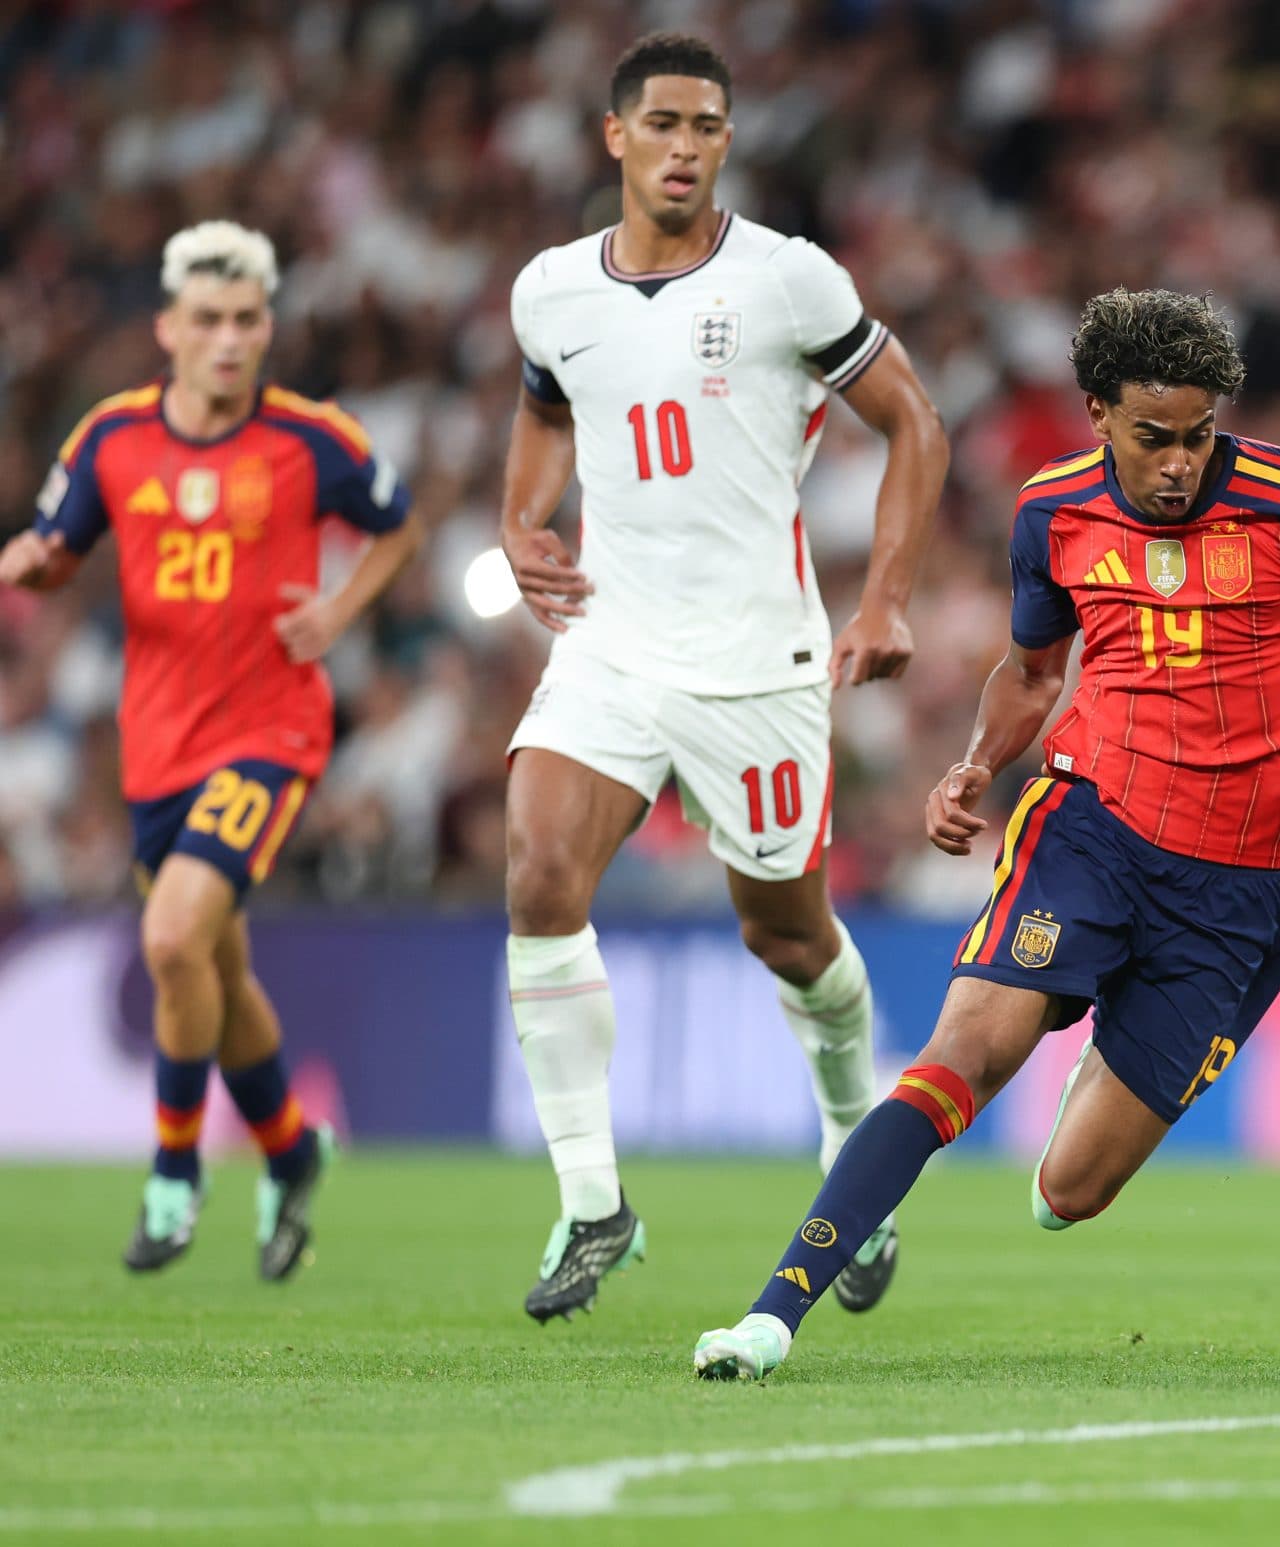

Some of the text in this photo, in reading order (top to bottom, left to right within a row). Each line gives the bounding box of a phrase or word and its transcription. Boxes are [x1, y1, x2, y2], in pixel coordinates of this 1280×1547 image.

[627, 399, 693, 481] 10
[155, 531, 233, 602] 20
[1135, 603, 1203, 670] 19
[186, 768, 272, 852] 20
[741, 759, 802, 833] 10
[1180, 1035, 1236, 1105] 19
